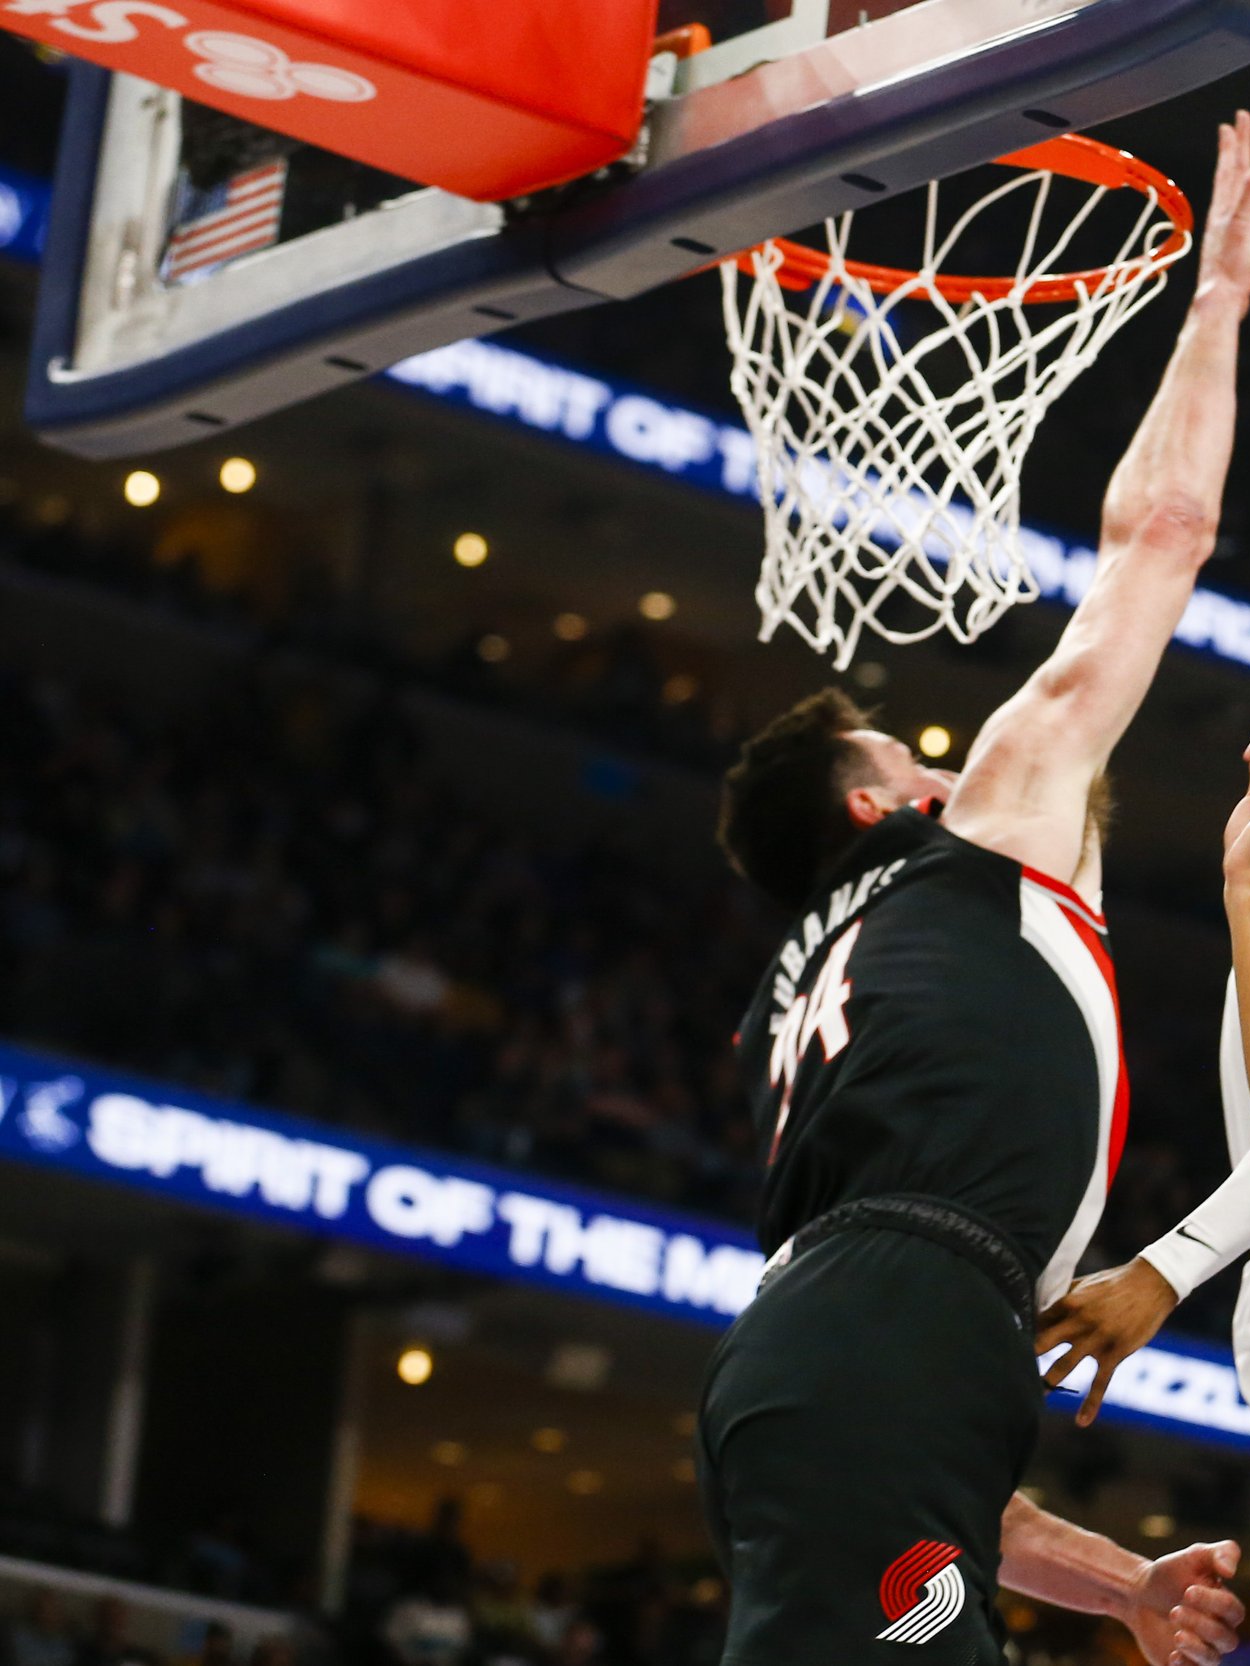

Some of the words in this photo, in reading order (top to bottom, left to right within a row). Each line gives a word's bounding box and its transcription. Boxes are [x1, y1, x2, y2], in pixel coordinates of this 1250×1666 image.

[86, 1092, 371, 1220] SPIRIT
[365, 1164, 496, 1248] OF
[498, 1192, 666, 1297] THE
